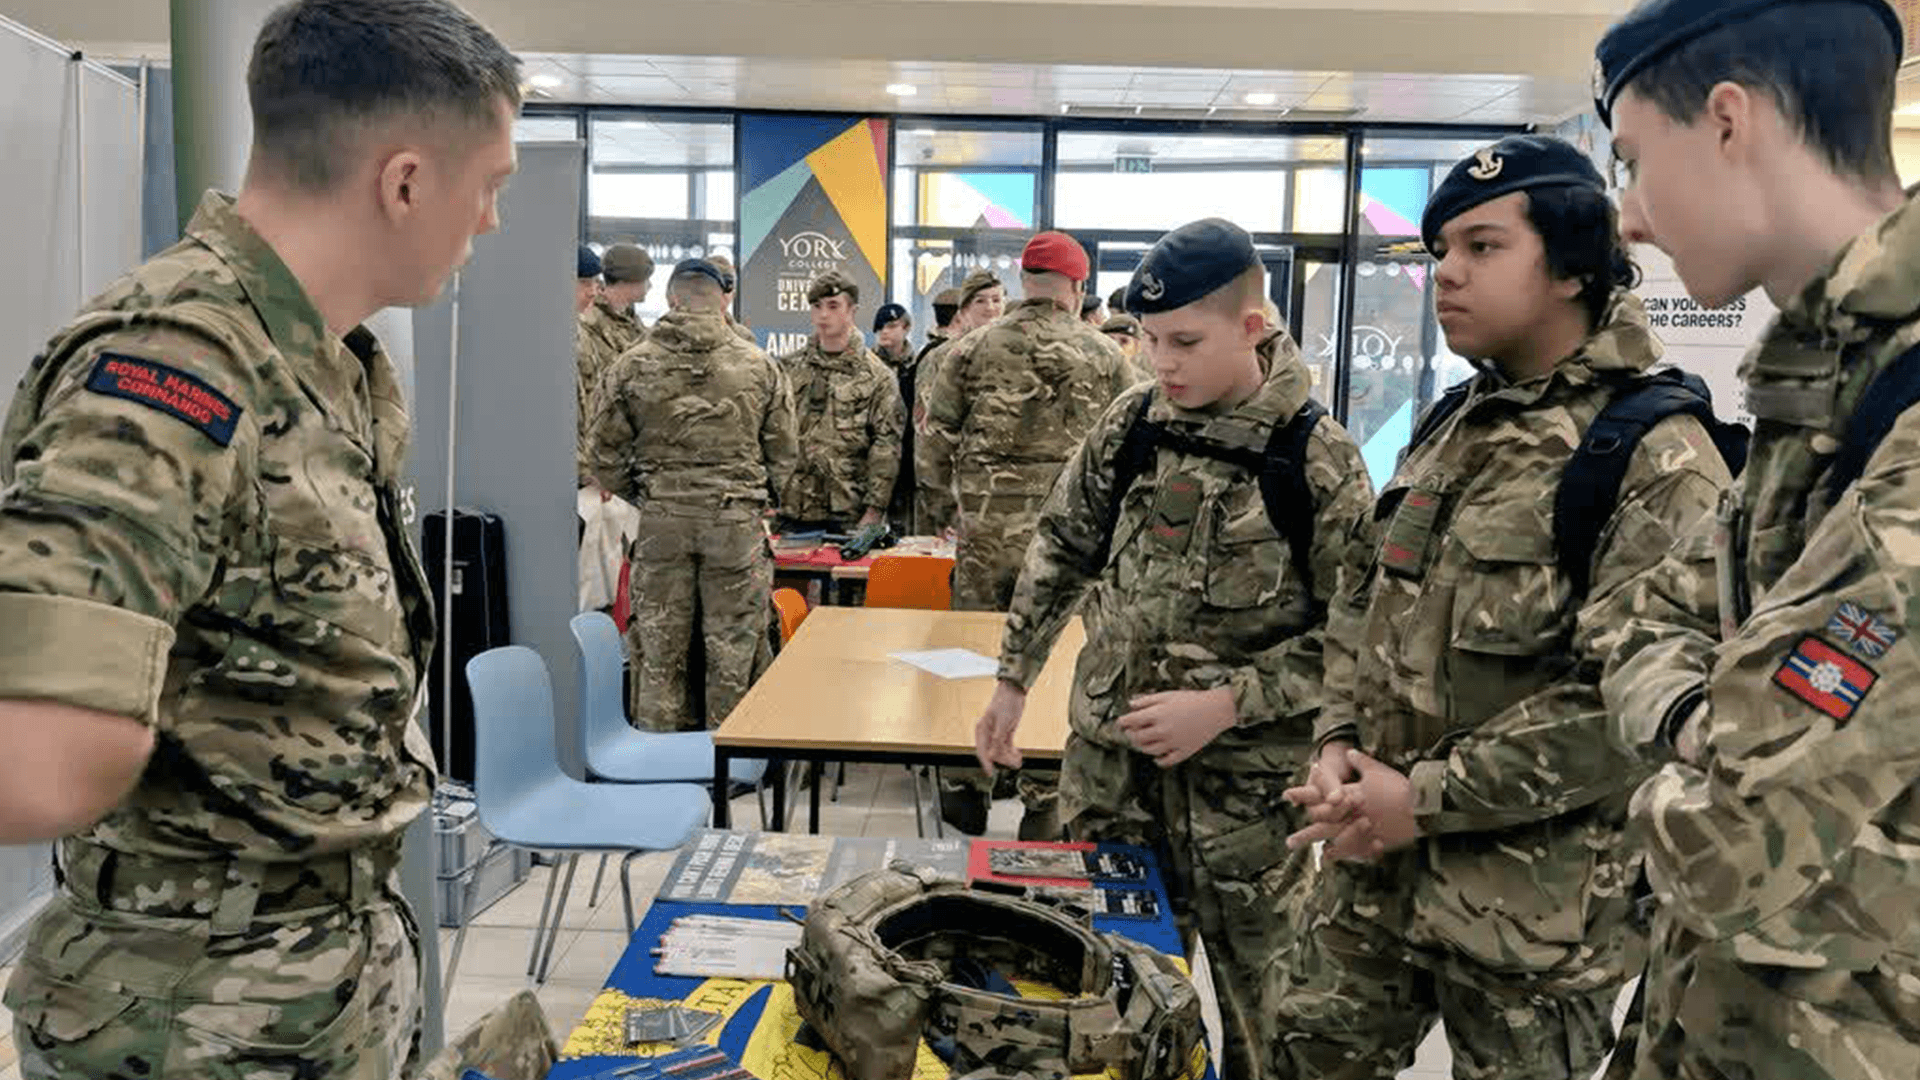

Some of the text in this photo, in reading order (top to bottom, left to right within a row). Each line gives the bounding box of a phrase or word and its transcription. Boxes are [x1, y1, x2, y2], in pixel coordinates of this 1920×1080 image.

[779, 236, 848, 260] YORK
[788, 260, 838, 270] COLLEGE
[777, 279, 811, 292] UNIVE
[777, 292, 811, 312] CEN
[105, 360, 233, 421] ROYAL MARINES
[117, 376, 214, 424] COMMANDO
